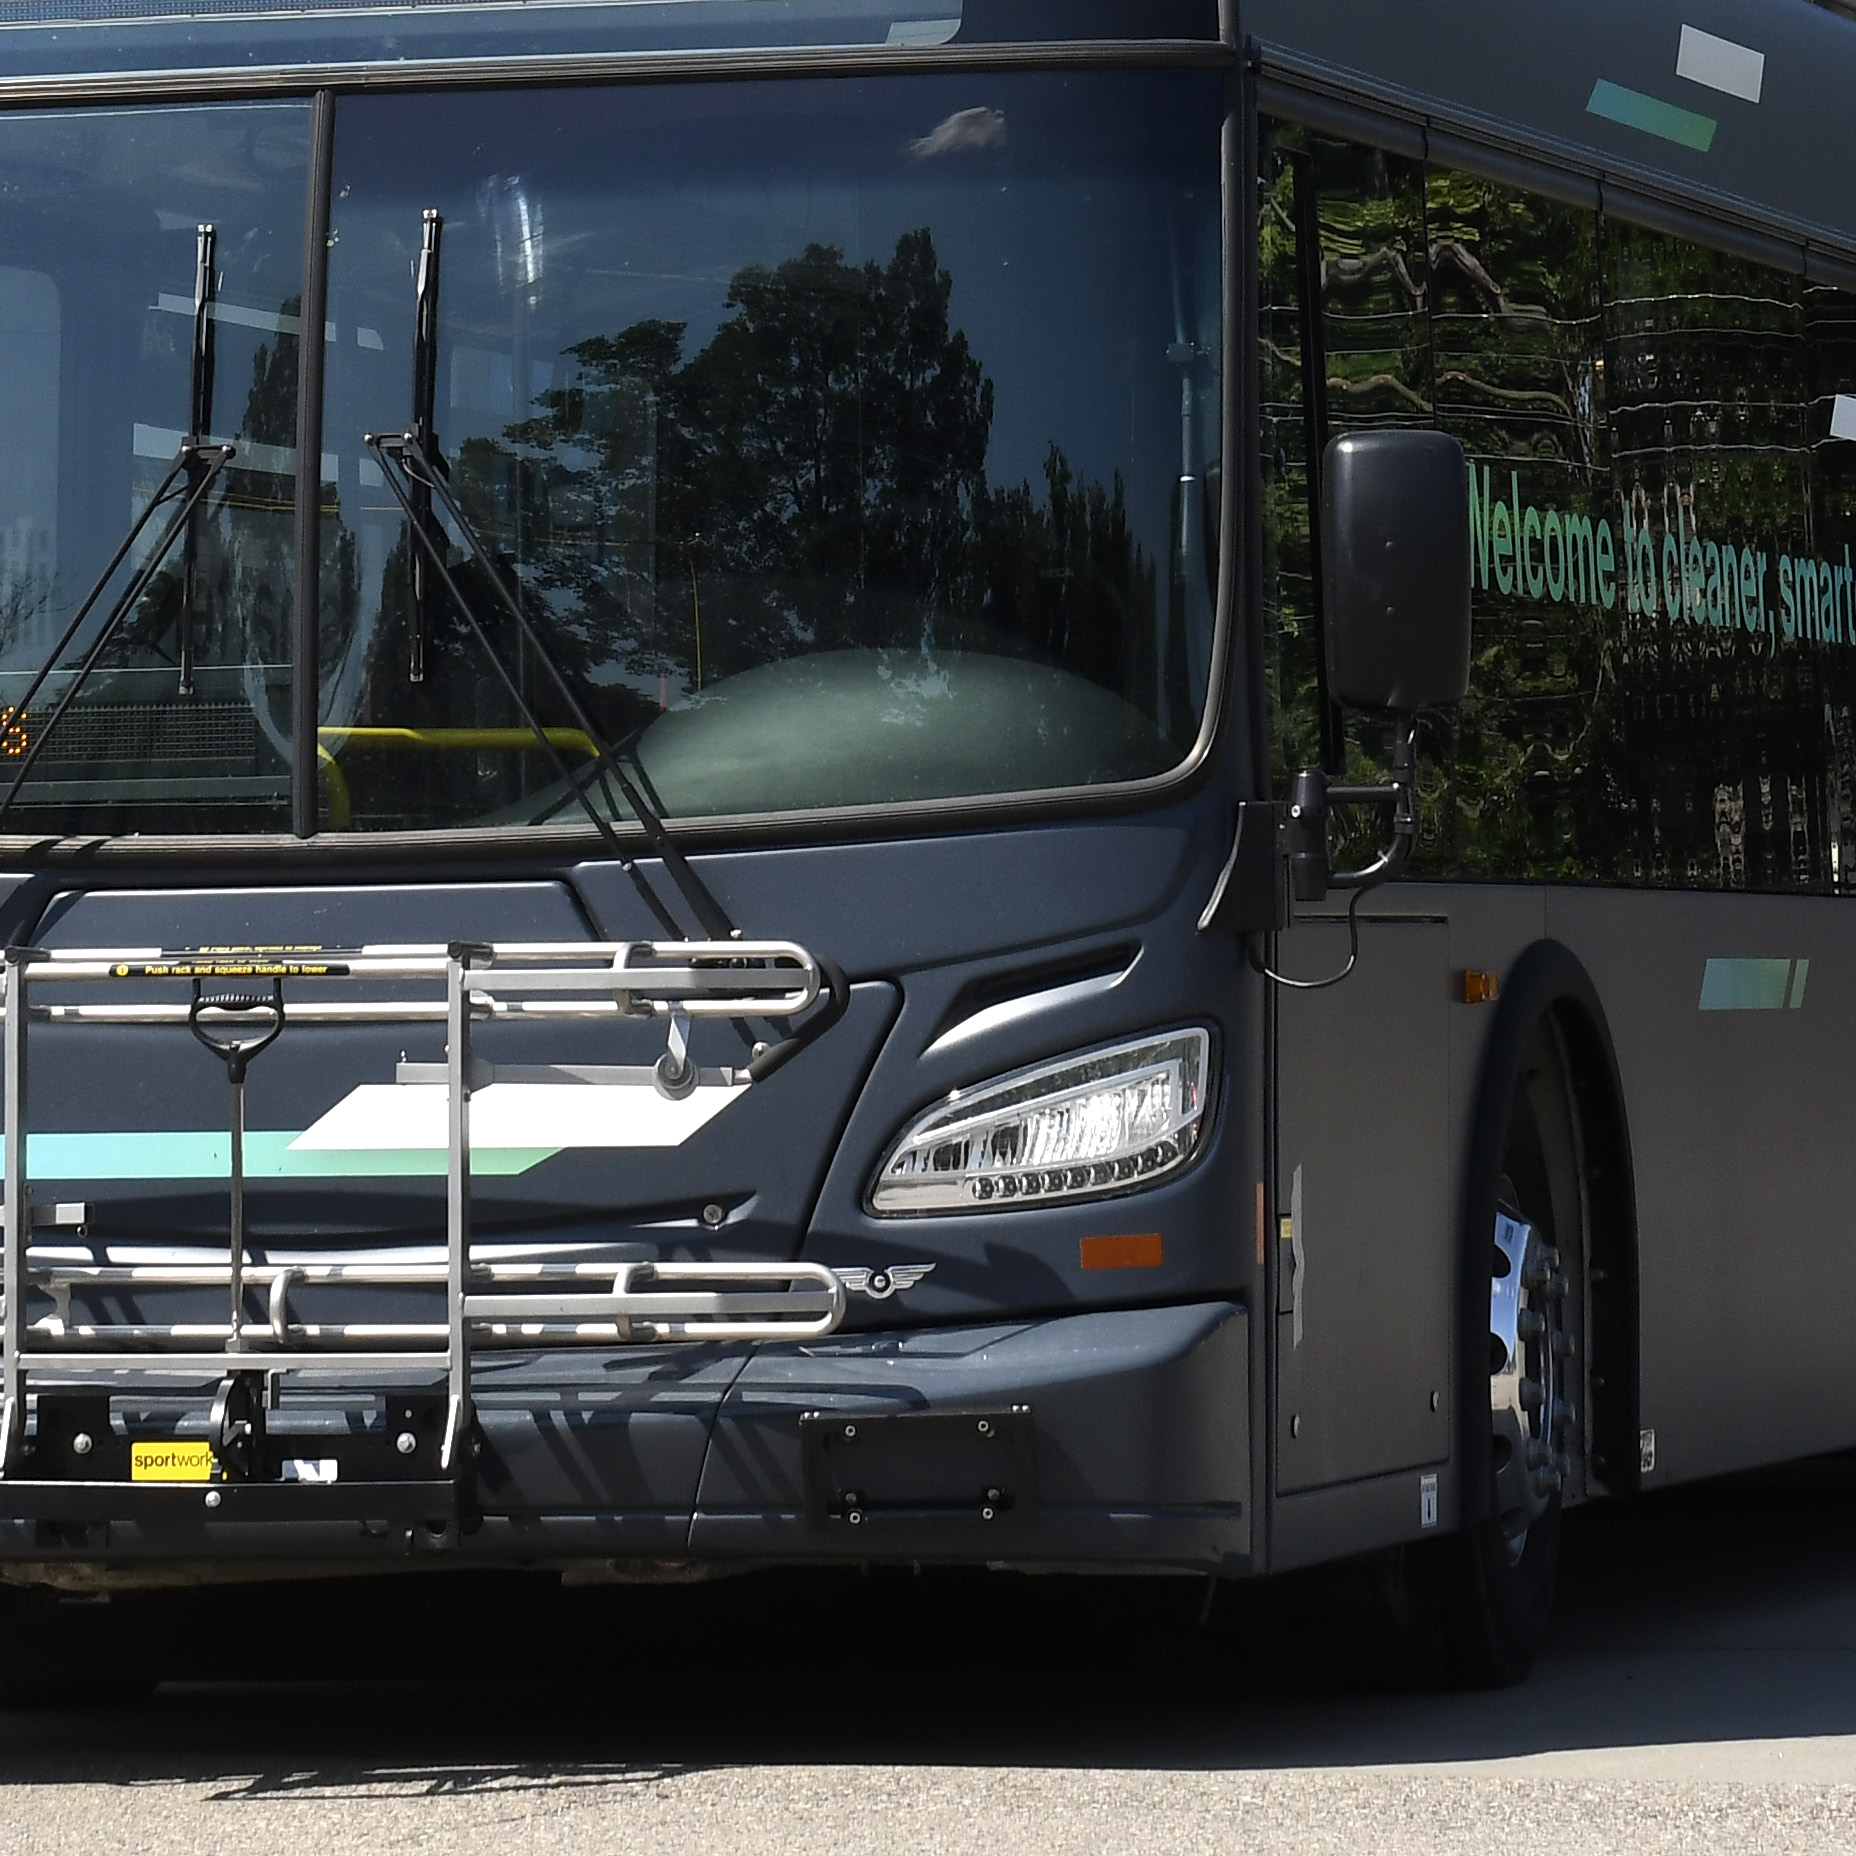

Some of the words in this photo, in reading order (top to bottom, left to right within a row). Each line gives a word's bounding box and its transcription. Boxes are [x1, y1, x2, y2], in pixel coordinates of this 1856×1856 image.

[1468, 463, 1616, 610] Welcome
[1624, 499, 1656, 617] to
[1663, 504, 1775, 659] cleaner,
[145, 964, 168, 974] Push
[171, 964, 191, 974] rack
[194, 964, 212, 974] and
[215, 964, 252, 975] squeeze
[255, 964, 286, 974] handle
[288, 964, 299, 974] to
[302, 964, 328, 974] lower
[135, 1451, 214, 1470] sportwork
